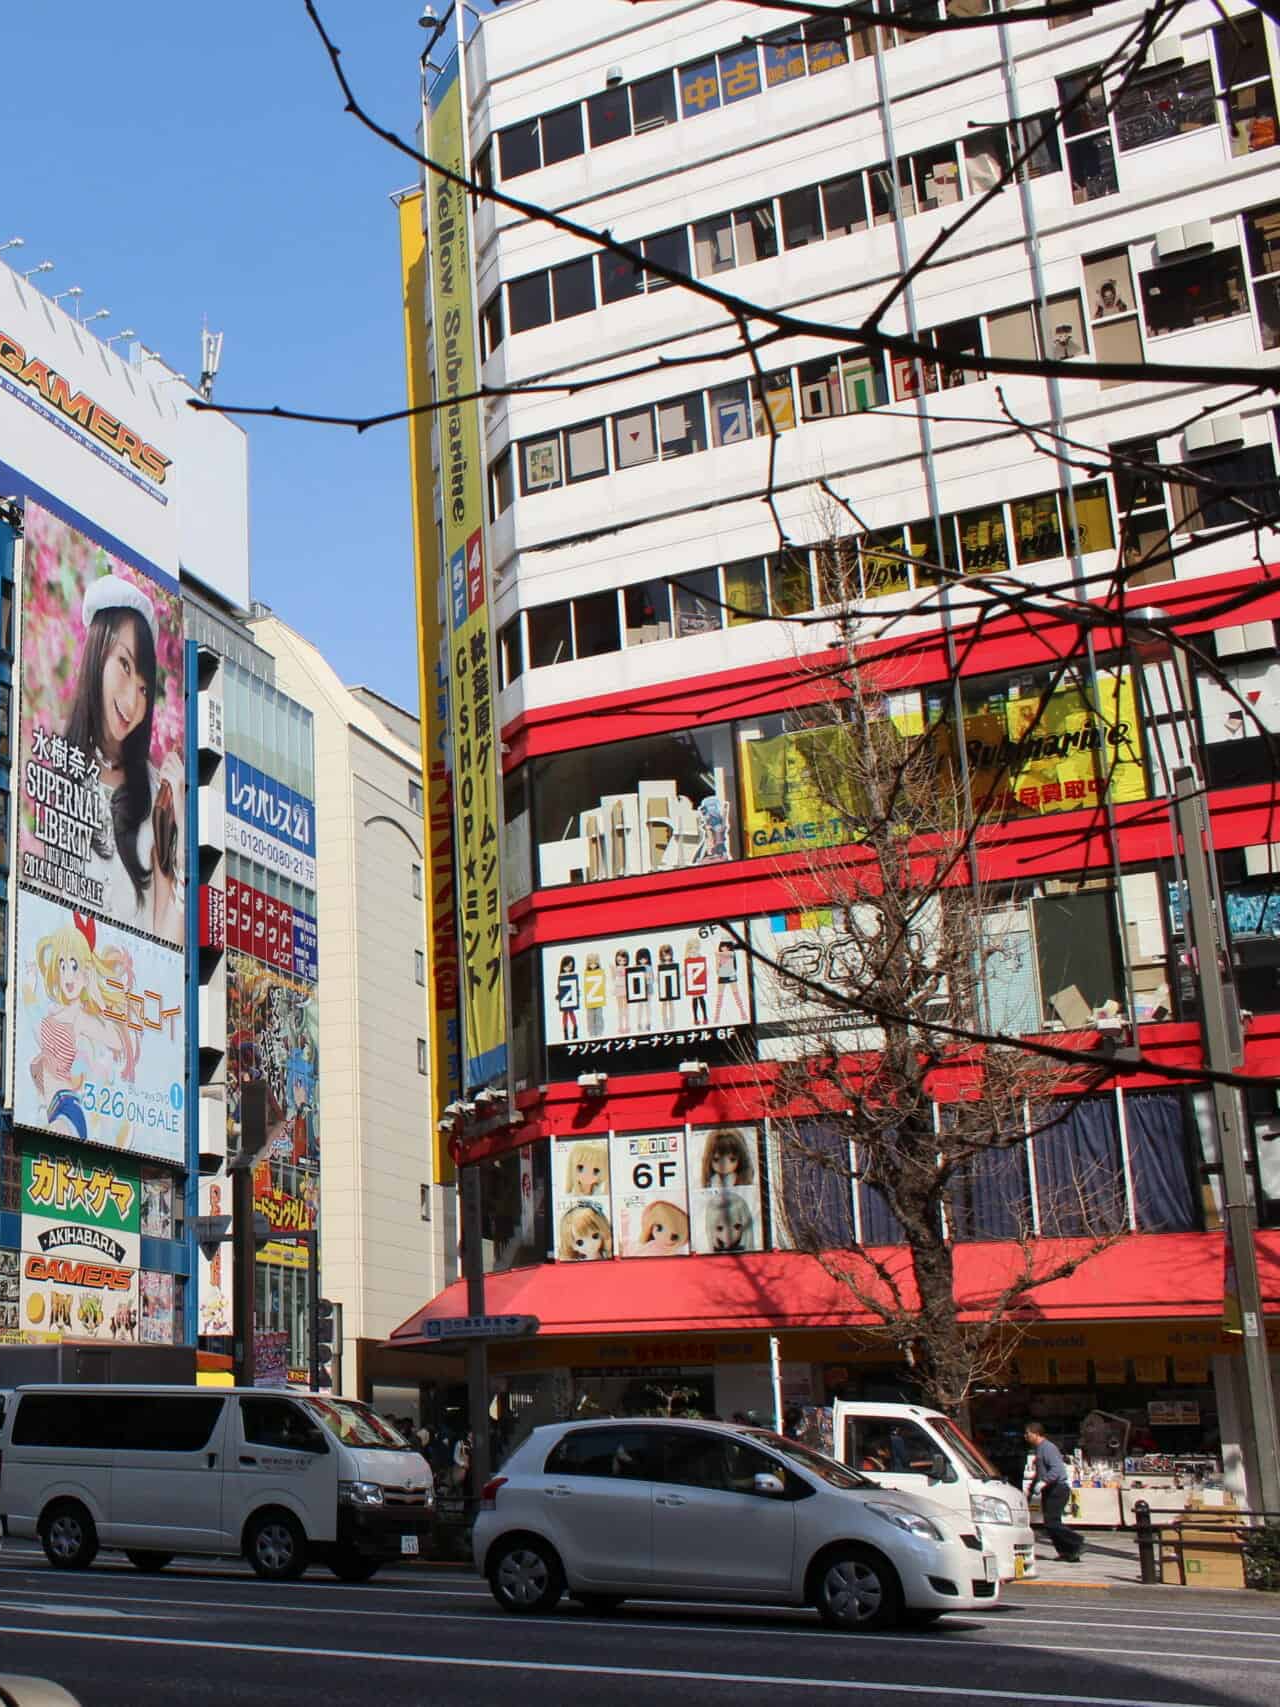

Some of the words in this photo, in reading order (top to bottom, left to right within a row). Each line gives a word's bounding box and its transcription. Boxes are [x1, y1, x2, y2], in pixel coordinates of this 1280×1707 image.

[684, 62, 760, 109] 中古
[450, 558, 466, 622] 5F
[468, 539, 482, 605] 4F
[32, 727, 101, 788] 水樹奈々
[26, 761, 103, 830] SUPERNAL
[470, 632, 504, 993] 秋葉原ゲームショップ
[34, 802, 95, 863] LIBERTY
[239, 829, 304, 875] 0120-0080-21
[64, 870, 78, 896] ON
[79, 876, 104, 906] SALE
[227, 885, 292, 924] メガネスーパー
[227, 907, 291, 949] コンタクト
[698, 925, 719, 941] 6F
[566, 1029, 712, 1057] アゾンインターナショナル
[716, 1027, 736, 1041] 6F
[83, 1082, 126, 1118] 3.26
[126, 1102, 145, 1123] ON
[147, 1108, 180, 1133] SALE
[631, 1161, 678, 1190] 6F
[253, 1199, 311, 1231] ードキングダム
[47, 1229, 119, 1259] AKIHABARA
[25, 1256, 133, 1290] GAMERS
